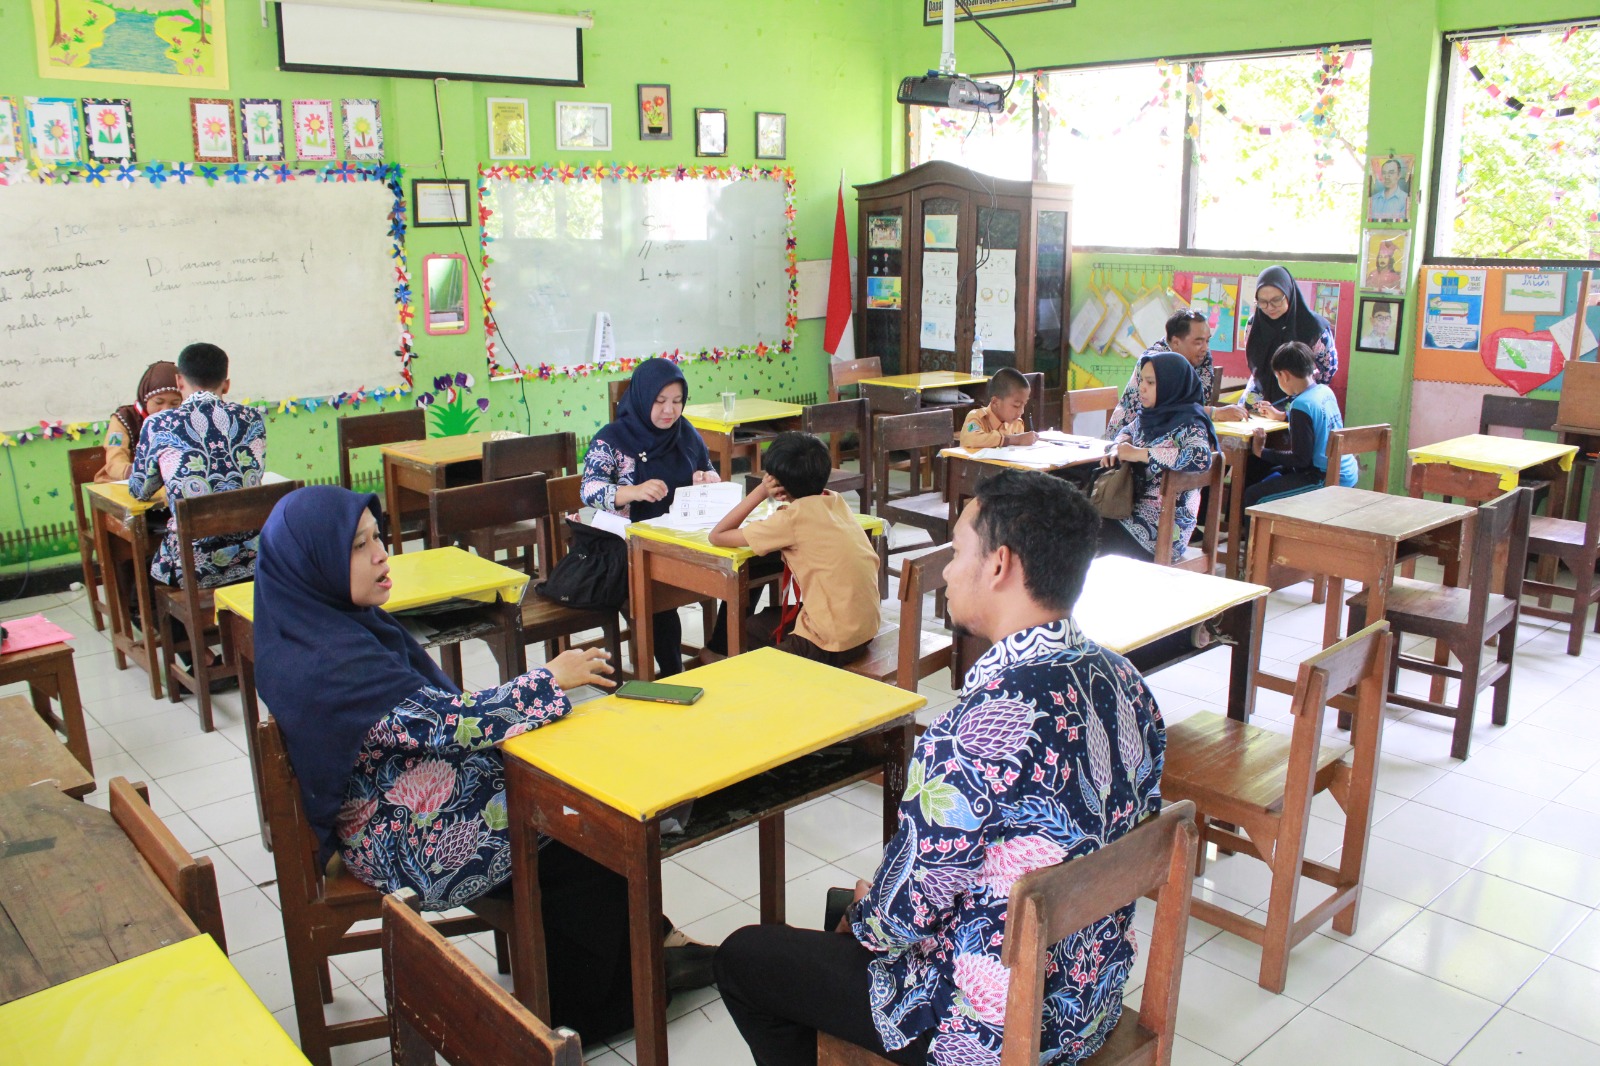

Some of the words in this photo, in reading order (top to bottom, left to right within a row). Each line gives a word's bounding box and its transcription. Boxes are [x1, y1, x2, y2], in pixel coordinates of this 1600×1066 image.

[43, 252, 110, 273] membawa
[231, 250, 280, 264] merokok
[21, 281, 72, 299] sekolah
[1521, 279, 1550, 287] JAWA
[55, 305, 94, 331] pajak
